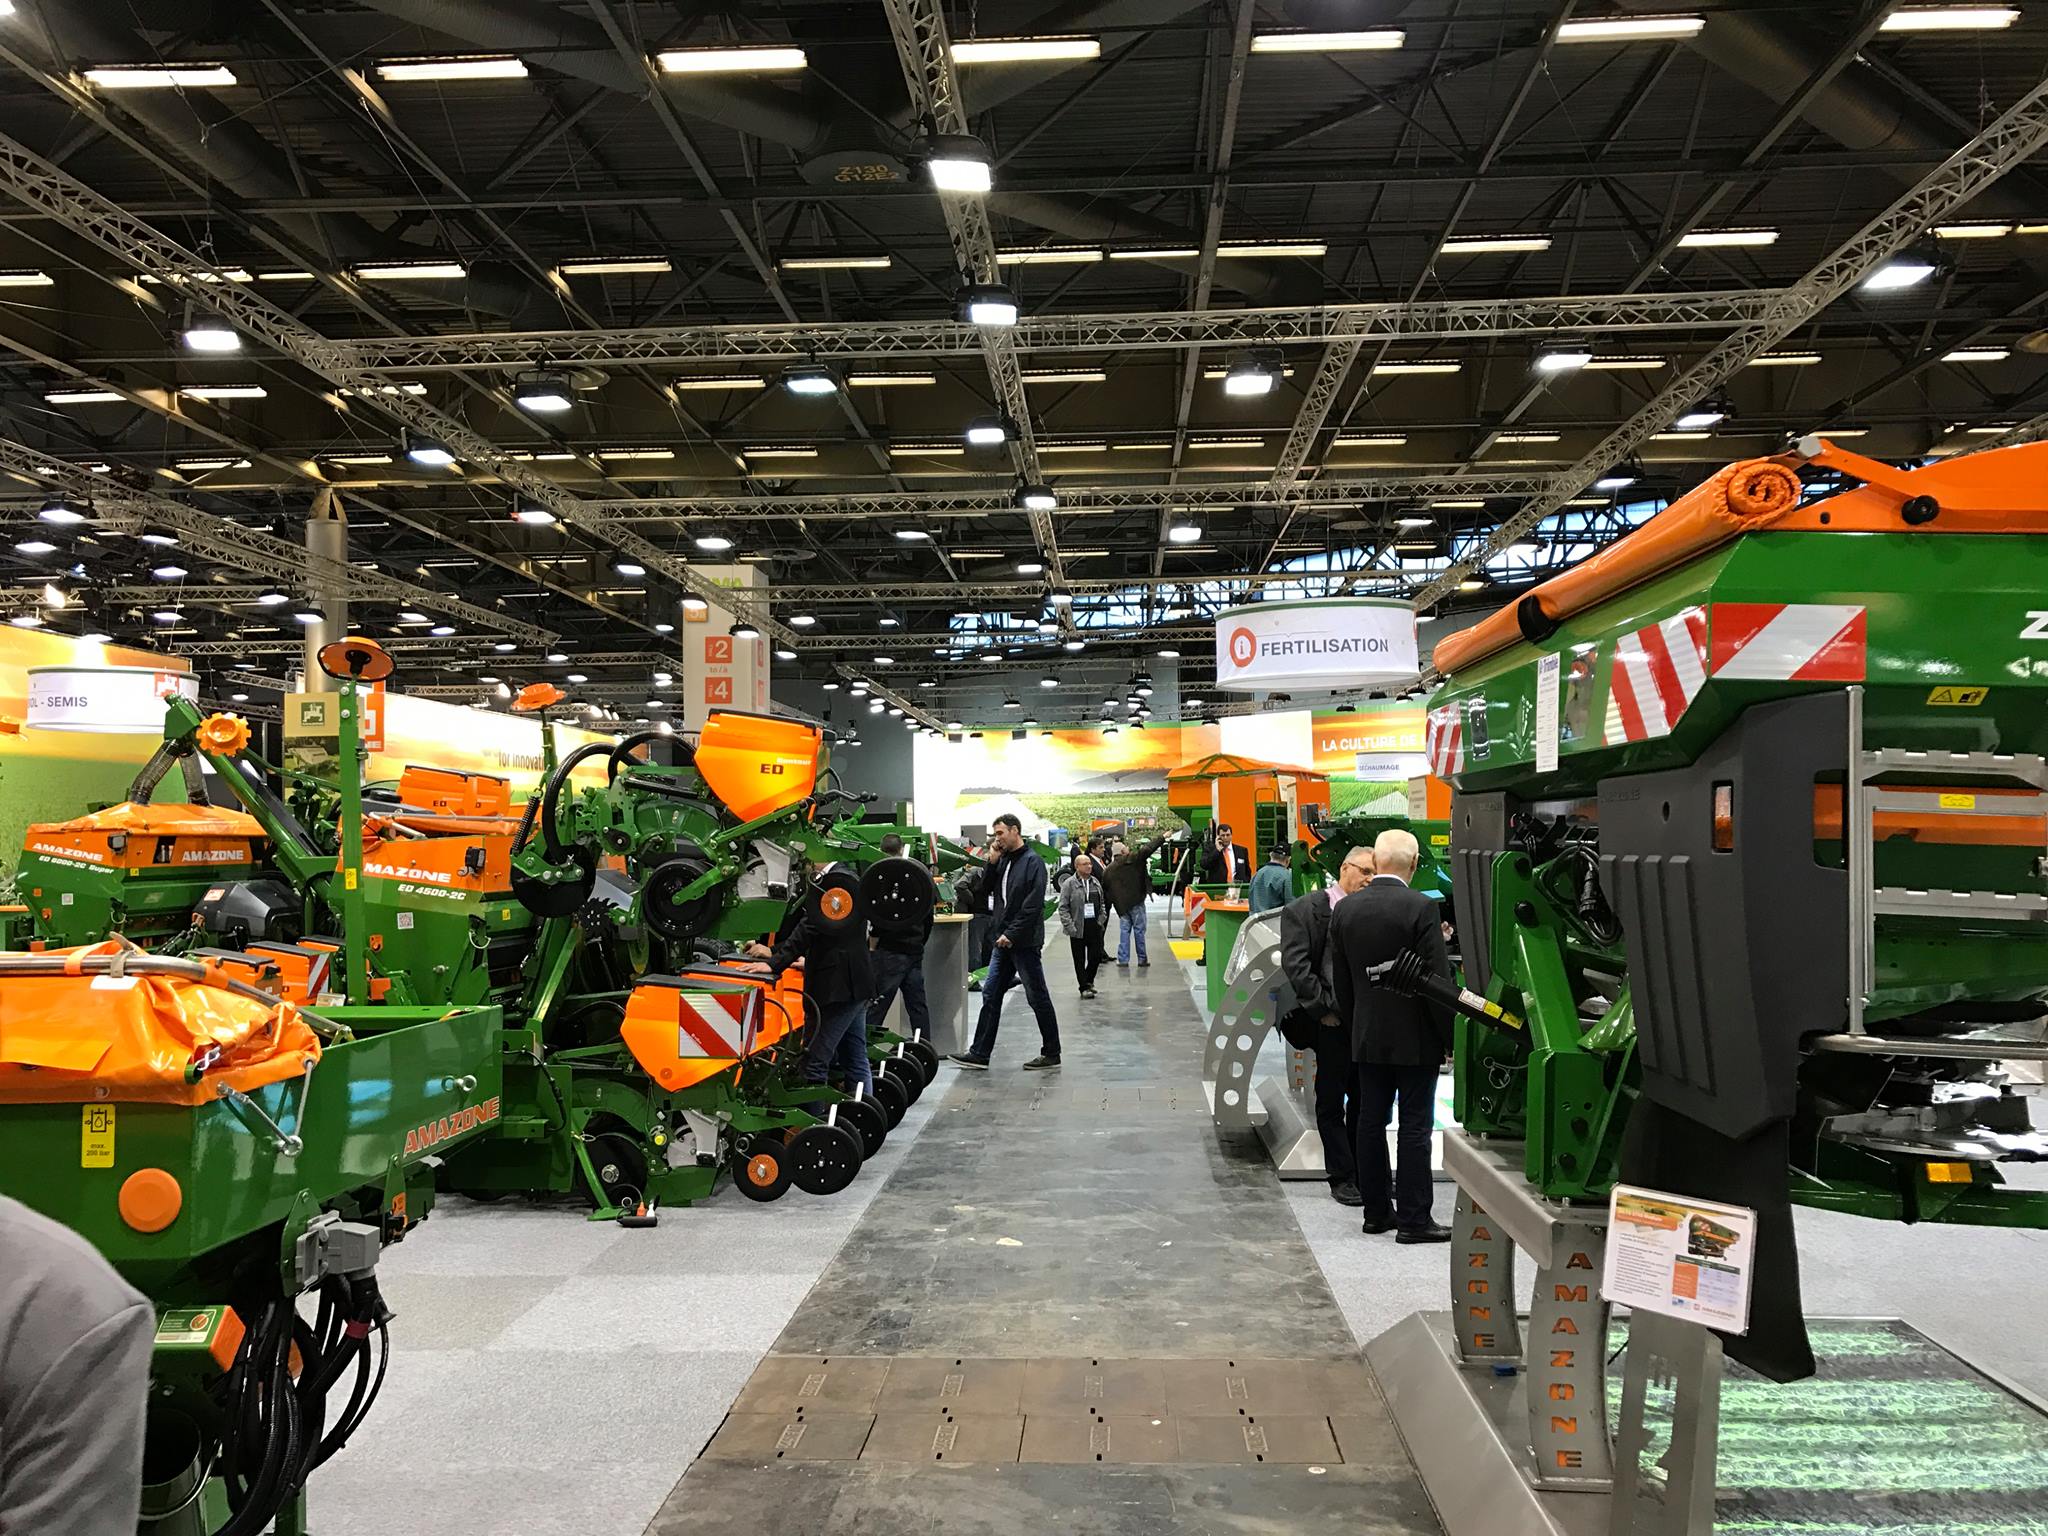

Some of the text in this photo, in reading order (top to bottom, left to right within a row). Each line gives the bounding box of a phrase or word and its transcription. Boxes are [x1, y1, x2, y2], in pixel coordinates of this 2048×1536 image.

[715, 640, 728, 658] 2
[1261, 638, 1389, 657] FERTILISATION
[714, 680, 728, 699] 4
[47, 696, 88, 708] SEMIS
[1322, 739, 1338, 752] LA
[1340, 735, 1397, 751] CULTURE
[512, 753, 545, 771] innovati
[760, 763, 784, 775] ED
[1087, 805, 1159, 815] www.amazone.fr
[32, 842, 104, 863] AMAZONE
[181, 849, 245, 863] AMAZONE
[88, 864, 115, 874] Super
[363, 862, 452, 883] MAZONE
[397, 883, 467, 901] ED 4500-2C
[403, 1095, 500, 1158] AMAZONE
[1467, 1199, 1495, 1348] AZONE
[1548, 1252, 1594, 1468] AMAZONE
